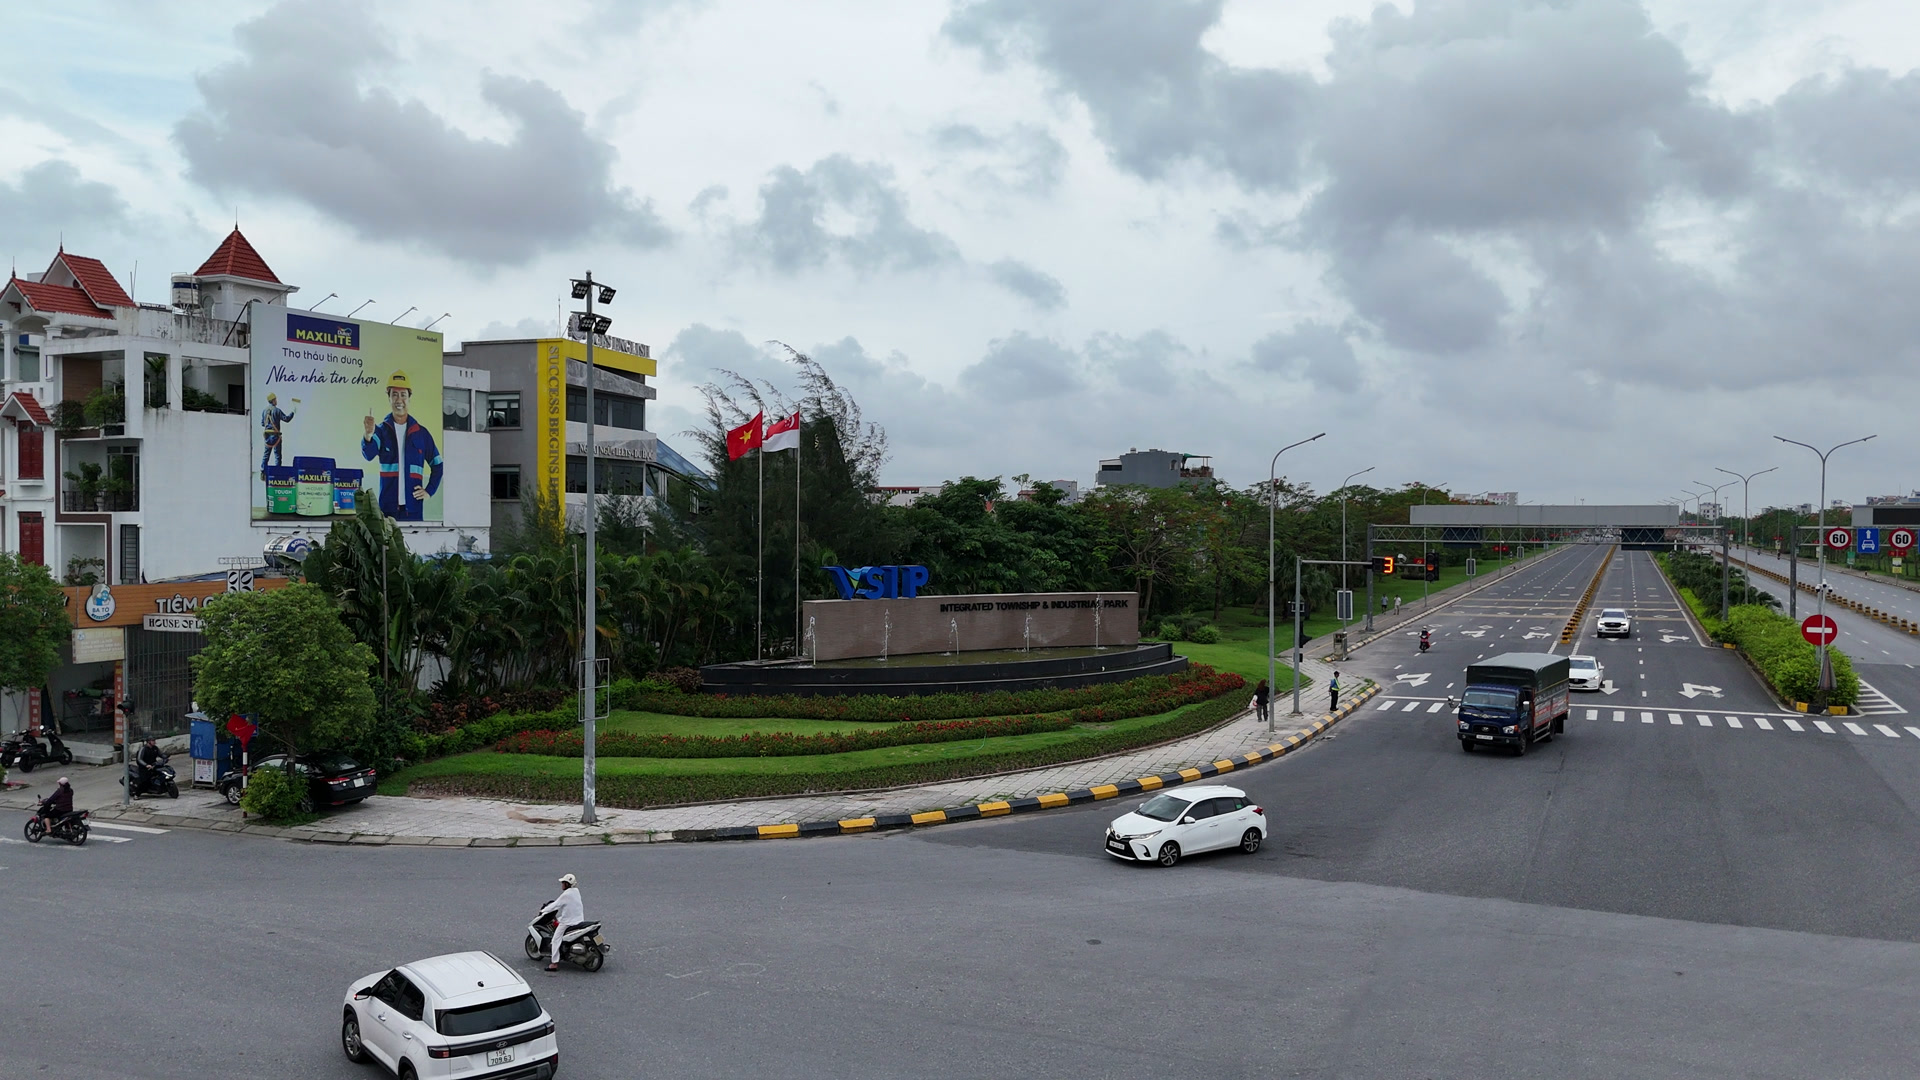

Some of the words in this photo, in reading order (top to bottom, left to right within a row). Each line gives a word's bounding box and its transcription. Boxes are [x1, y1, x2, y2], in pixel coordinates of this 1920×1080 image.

[296, 328, 352, 346] MAXILITE
[326, 353, 339, 363] tin
[265, 364, 298, 385] Nhà
[300, 368, 328, 383] nhà
[330, 370, 349, 386] tin
[351, 370, 380, 387] chọn
[548, 345, 560, 415] SUCCESS
[548, 417, 560, 474] BEGINS
[268, 479, 296, 487] MAXILITE
[298, 474, 332, 482] MAXILITE
[1832, 533, 1846, 544] 60
[1895, 534, 1909, 545] 60
[1384, 556, 1394, 574] 3
[820, 564, 929, 600] VSIP
[940, 602, 994, 613] INTEGRATED
[996, 600, 1041, 611] TOWNSHIP
[1042, 601, 1049, 609] &
[1104, 599, 1128, 608] PARK
[148, 618, 180, 629] HOUSE
[181, 618, 195, 629] OF
[495, 1049, 507, 1057] 15K
